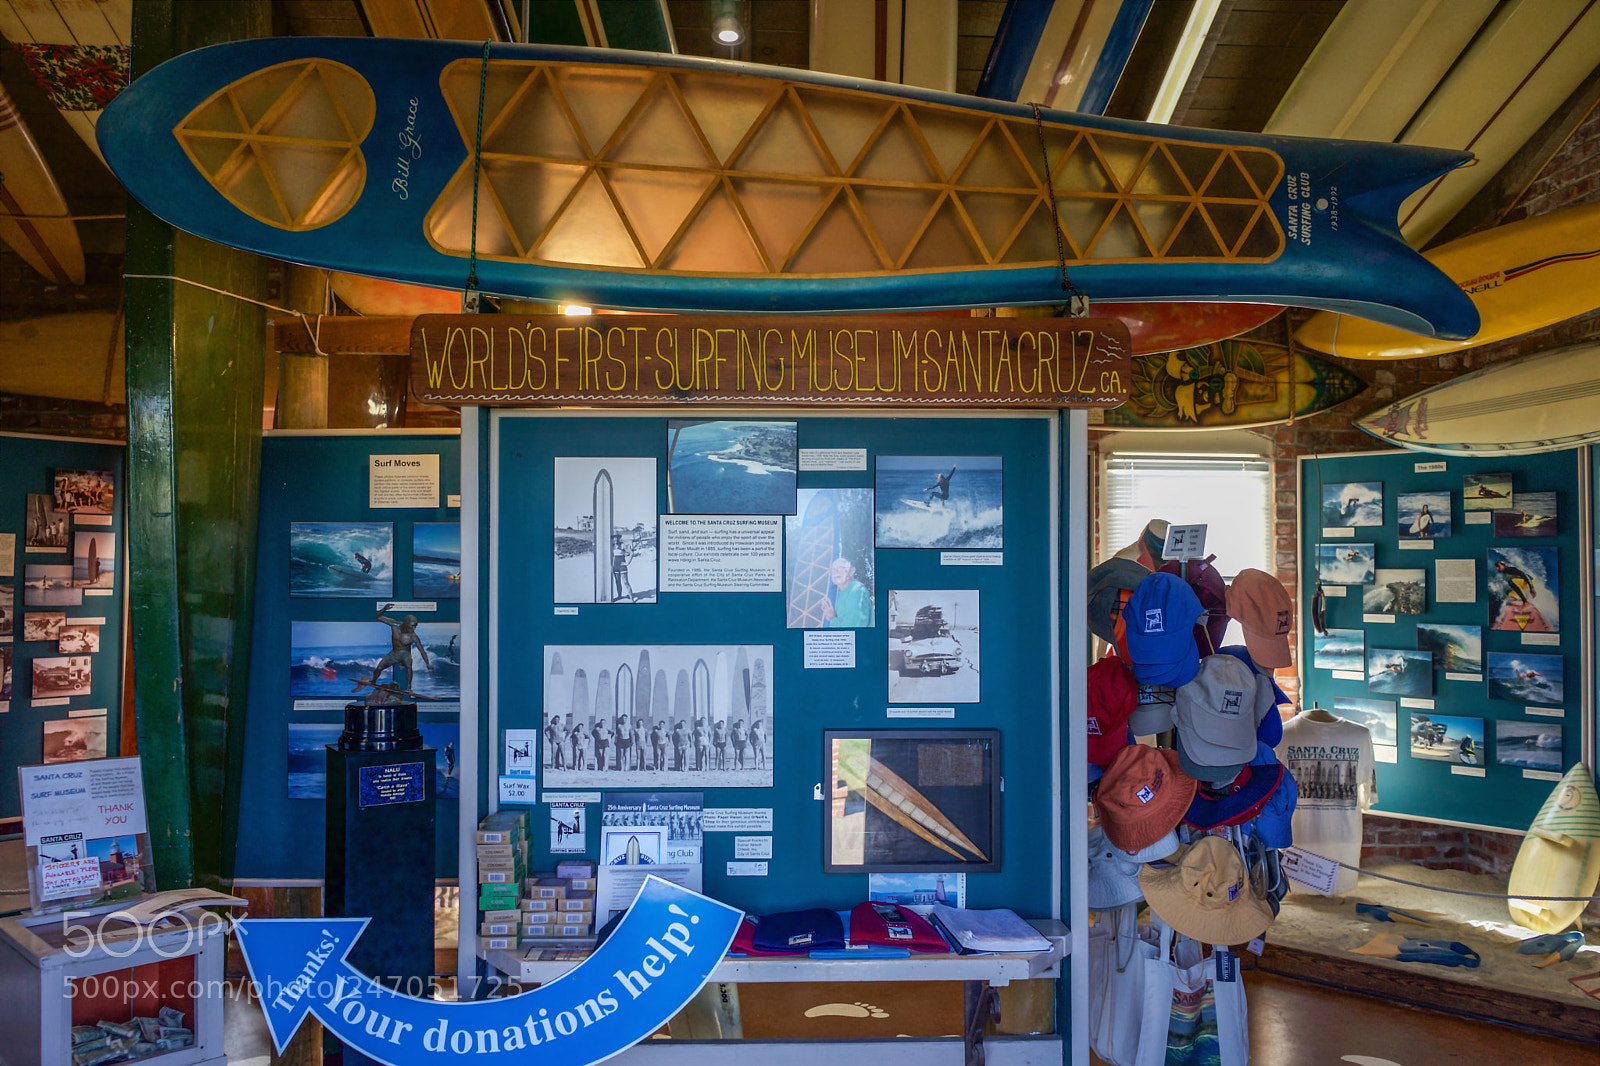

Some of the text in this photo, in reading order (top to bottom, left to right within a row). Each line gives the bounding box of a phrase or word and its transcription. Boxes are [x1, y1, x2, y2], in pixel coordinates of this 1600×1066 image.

[392, 96, 421, 200] Bill Grace
[1287, 174, 1298, 240] SANTA CRUZ
[1300, 172, 1312, 246] SURFING CLUB
[421, 320, 547, 390] WORLD'S
[1288, 746, 1360, 754] SANTA CRUZ
[30, 790, 53, 800] SURF
[34, 773, 62, 782] SANTA
[98, 802, 134, 814] THANK
[105, 815, 128, 825] YOU
[40, 833, 82, 844] SANTA CRUZ
[271, 928, 342, 1014] Thanks!
[323, 904, 700, 1055] Your donations help!
